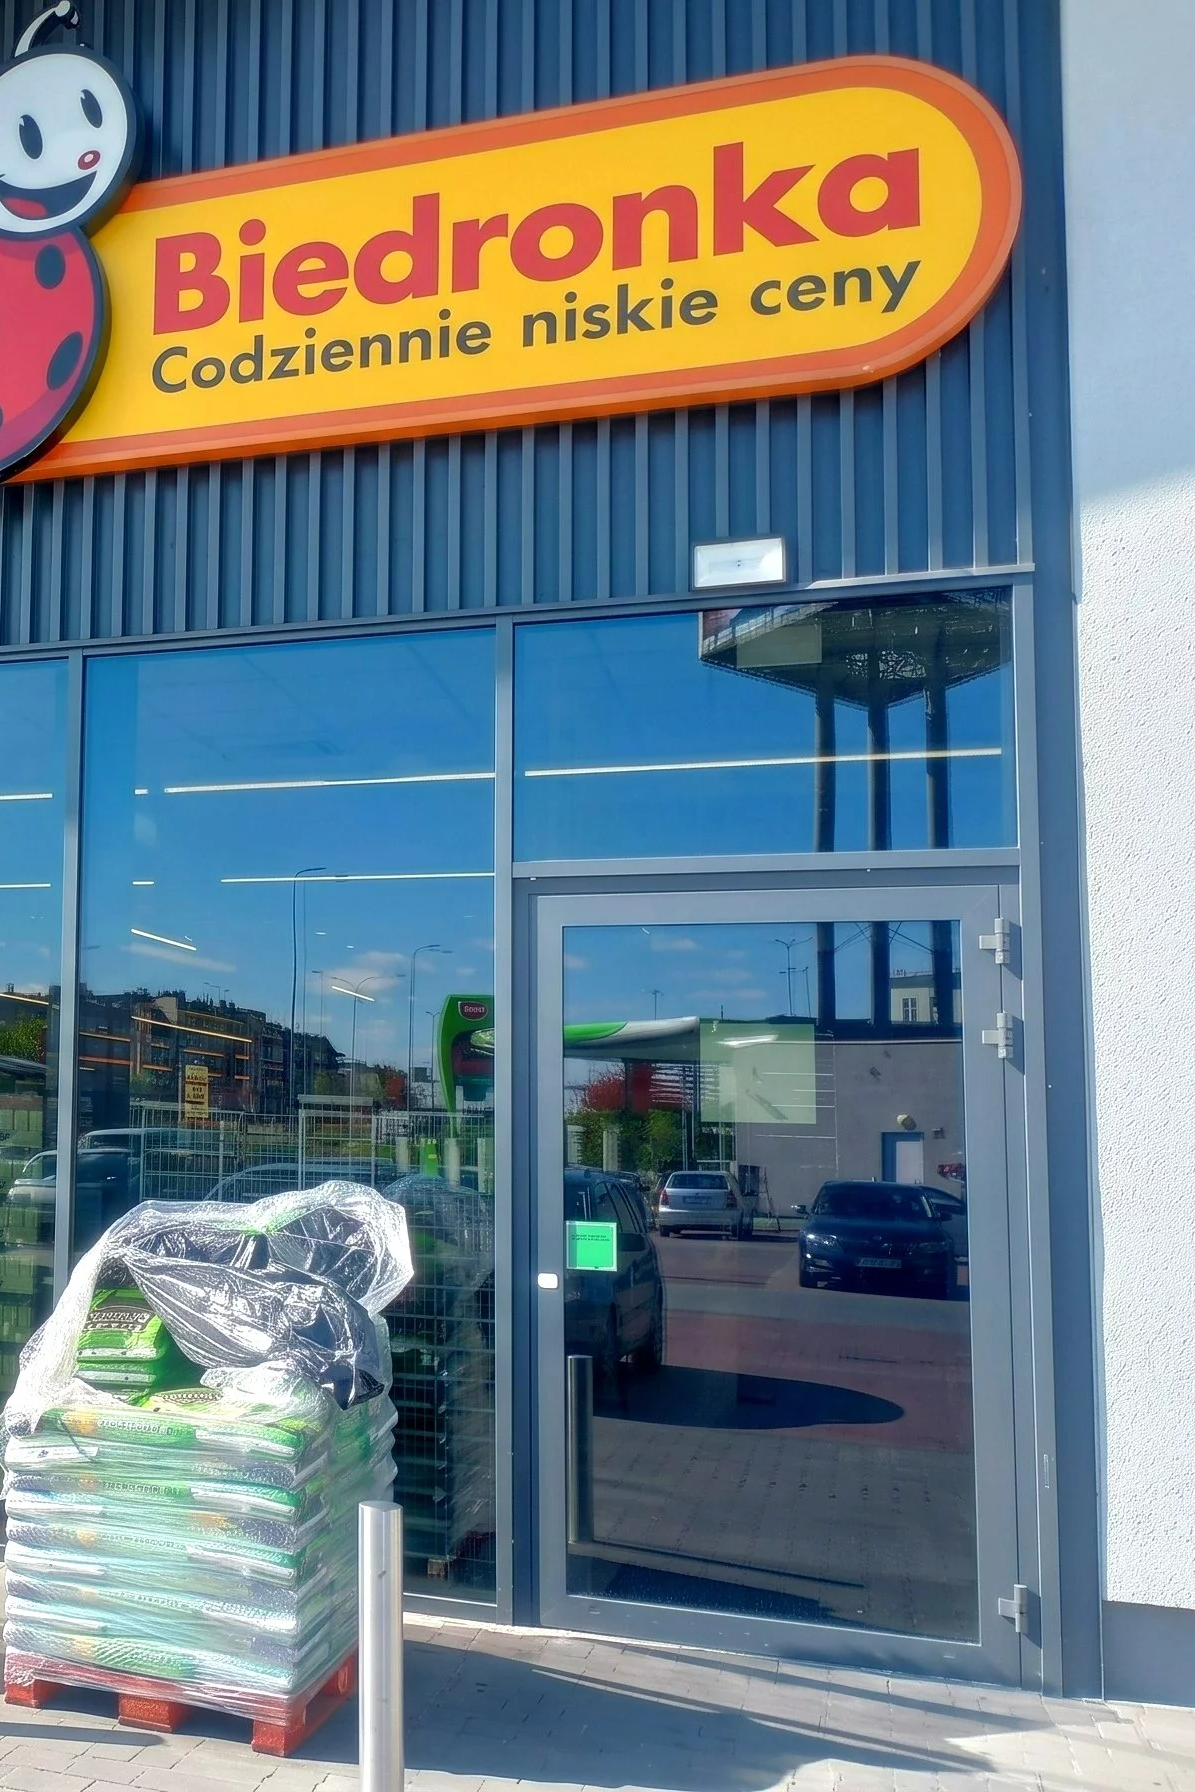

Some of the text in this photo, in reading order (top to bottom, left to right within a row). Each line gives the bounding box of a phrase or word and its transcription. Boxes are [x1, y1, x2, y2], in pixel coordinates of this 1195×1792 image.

[153, 141, 921, 336] Biedronka
[152, 260, 921, 393] Codziennie niskie ceny
